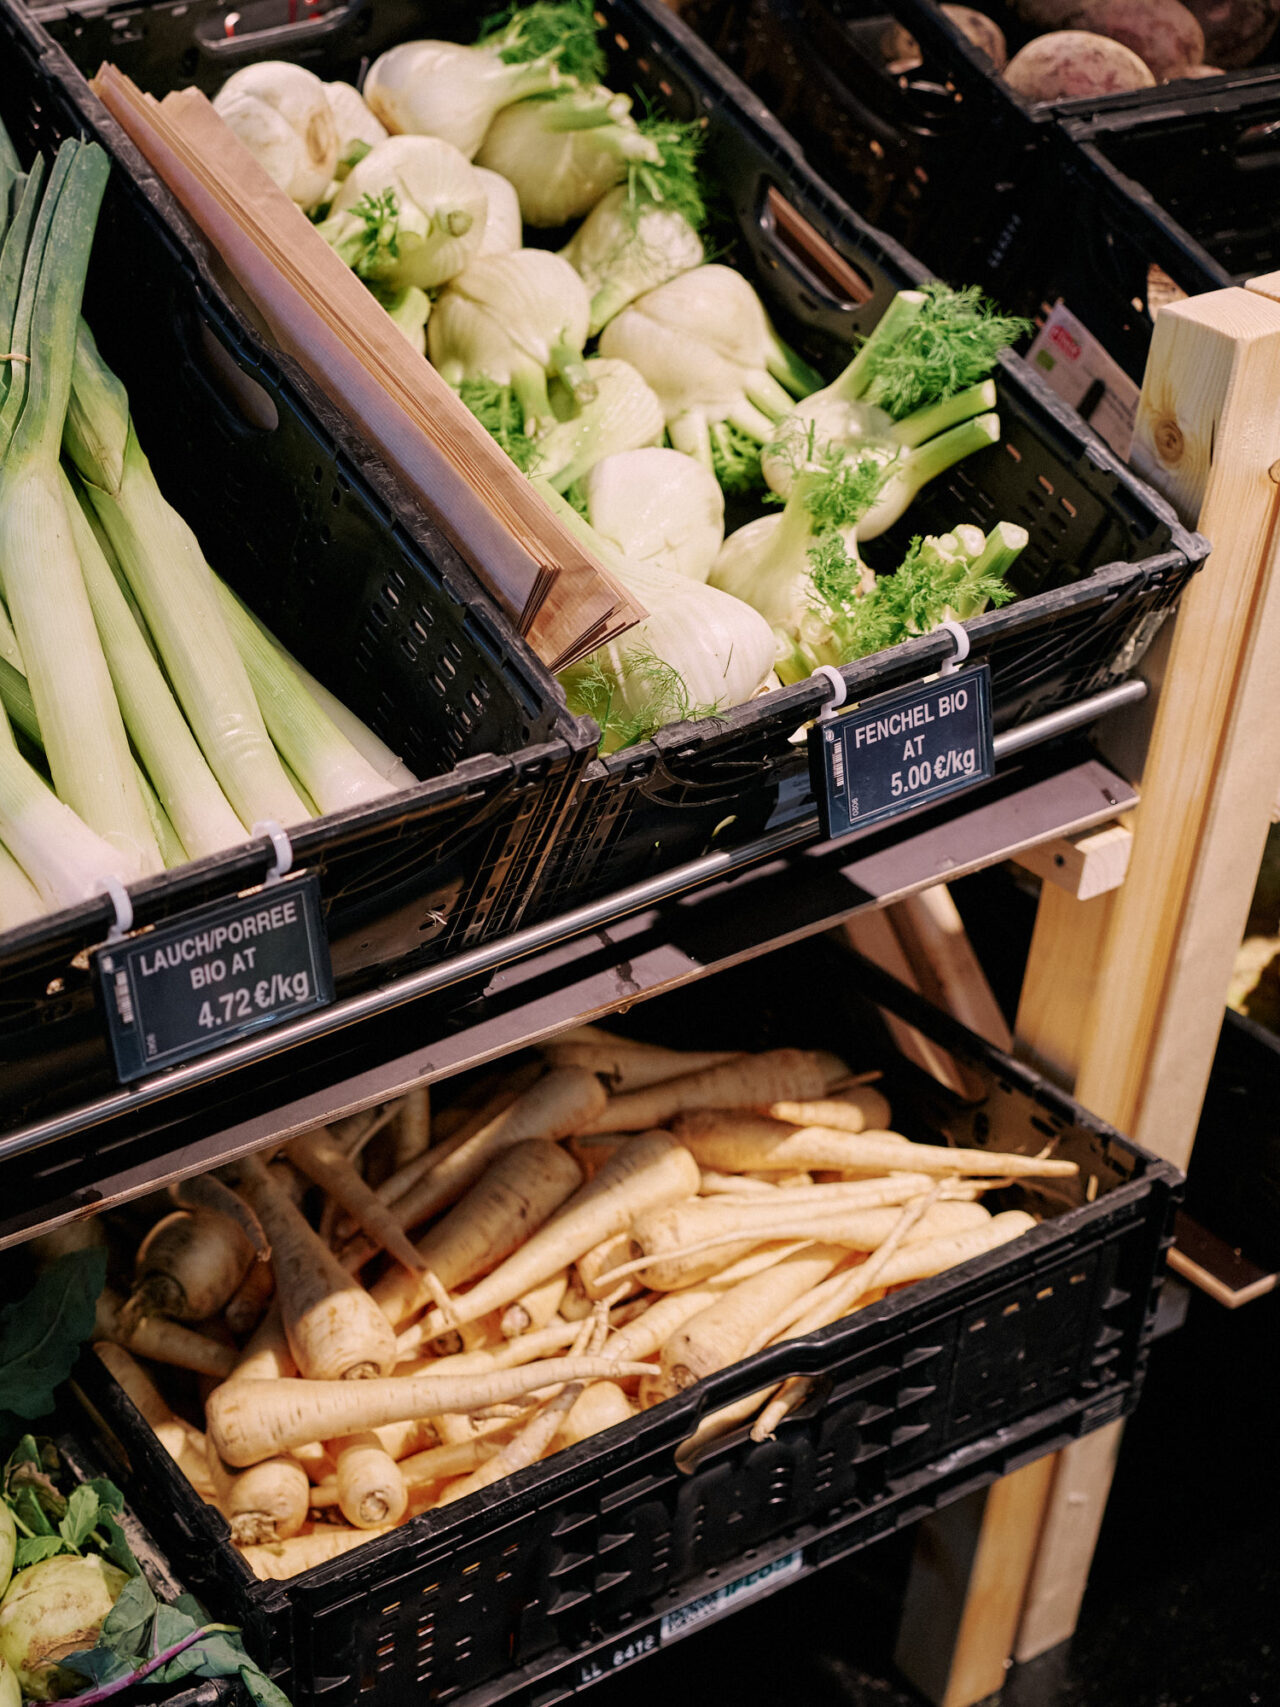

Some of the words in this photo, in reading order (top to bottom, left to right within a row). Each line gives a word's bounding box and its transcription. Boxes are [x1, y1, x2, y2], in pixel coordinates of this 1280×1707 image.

[855, 703, 934, 748] FENCHEL
[938, 689, 968, 718] BIO
[902, 735, 925, 761] AT
[140, 902, 297, 976] LAUCH/PORREE
[190, 961, 226, 990] BIO
[232, 948, 256, 975] AT
